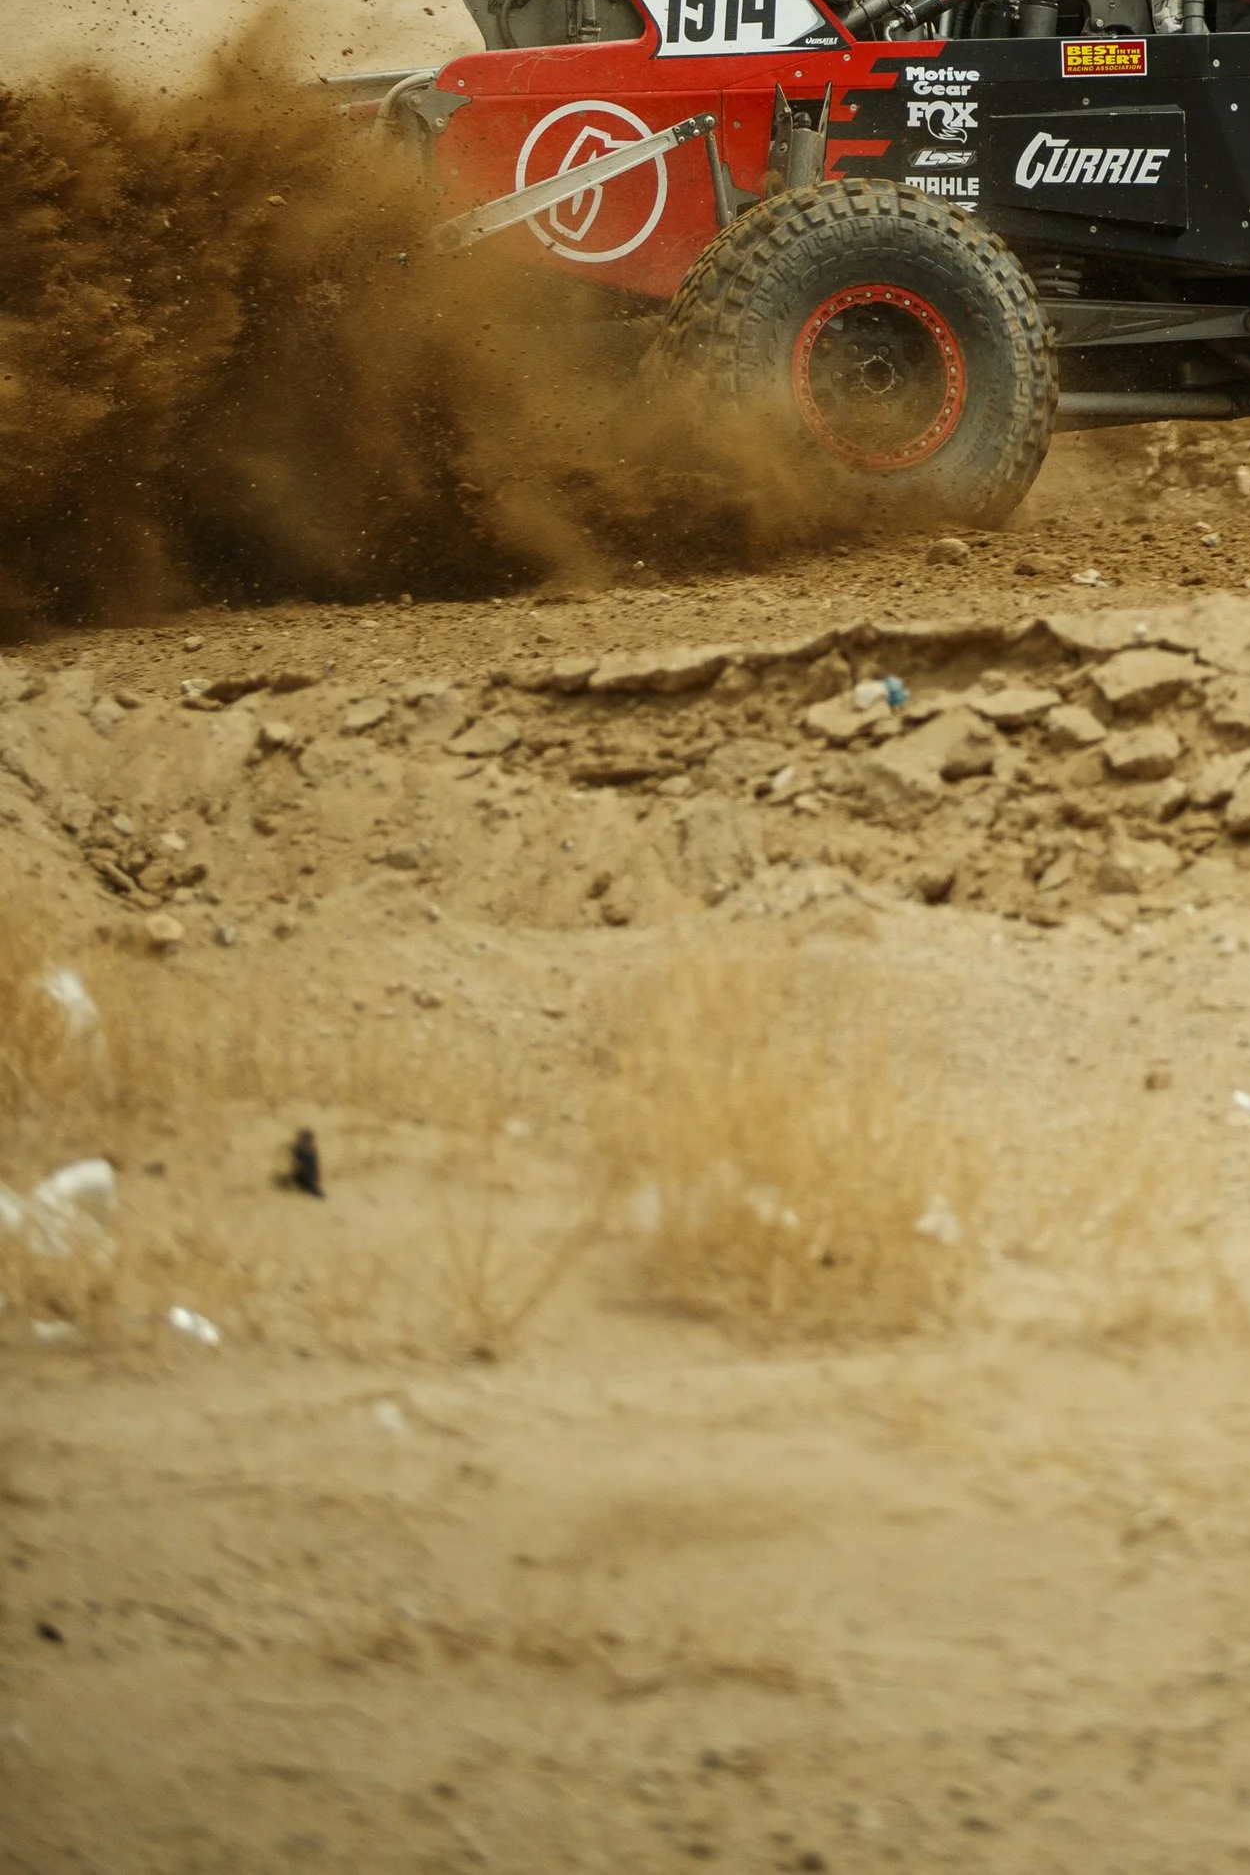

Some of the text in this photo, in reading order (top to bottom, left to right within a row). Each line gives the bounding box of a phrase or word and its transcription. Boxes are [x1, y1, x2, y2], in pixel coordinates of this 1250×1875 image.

[1066, 45, 1119, 55] BEST
[1067, 54, 1141, 66] DESERT
[905, 66, 981, 82] Motive
[912, 81, 971, 97] Gear
[907, 100, 978, 144] FOX
[1015, 131, 1171, 189] CURRIE
[905, 176, 980, 196] MAHLE
